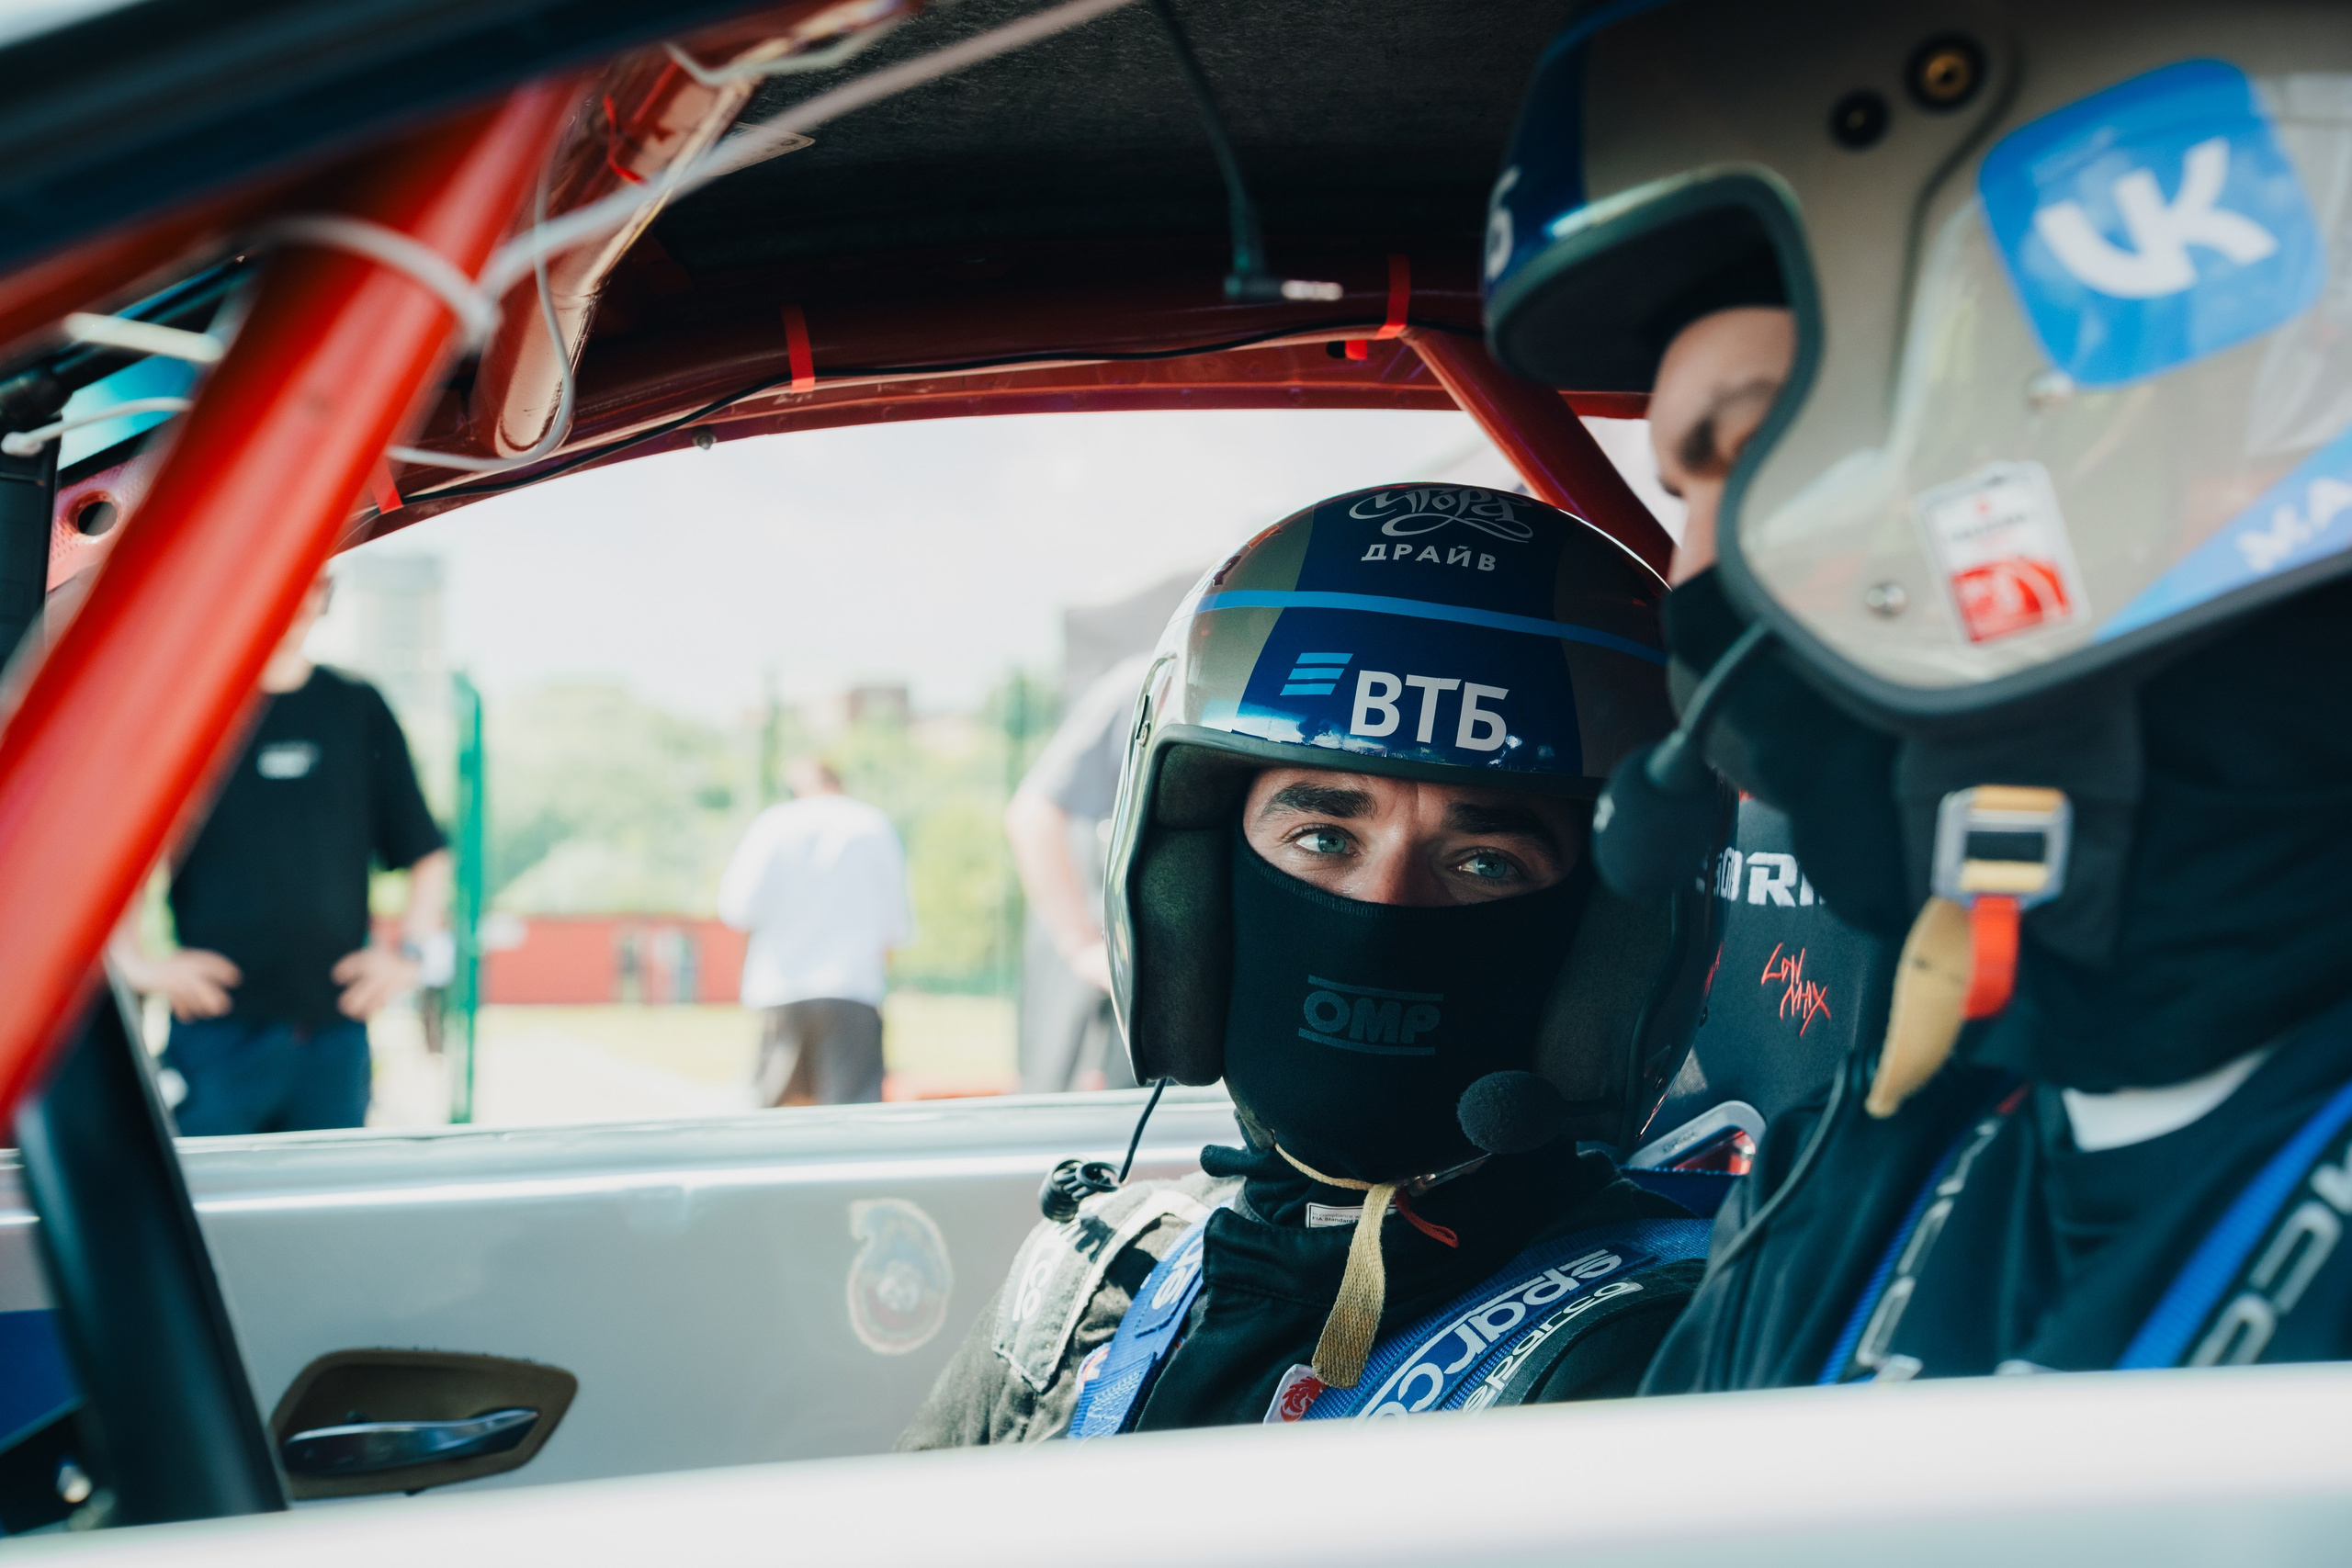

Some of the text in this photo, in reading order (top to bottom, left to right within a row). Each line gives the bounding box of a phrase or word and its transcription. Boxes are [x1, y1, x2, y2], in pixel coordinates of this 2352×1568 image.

[2034, 136, 2278, 299] VK
[1361, 543, 1497, 571] ДРАЙВ
[1350, 670, 1510, 752] ВТБ
[1303, 989, 1442, 1044] OMP
